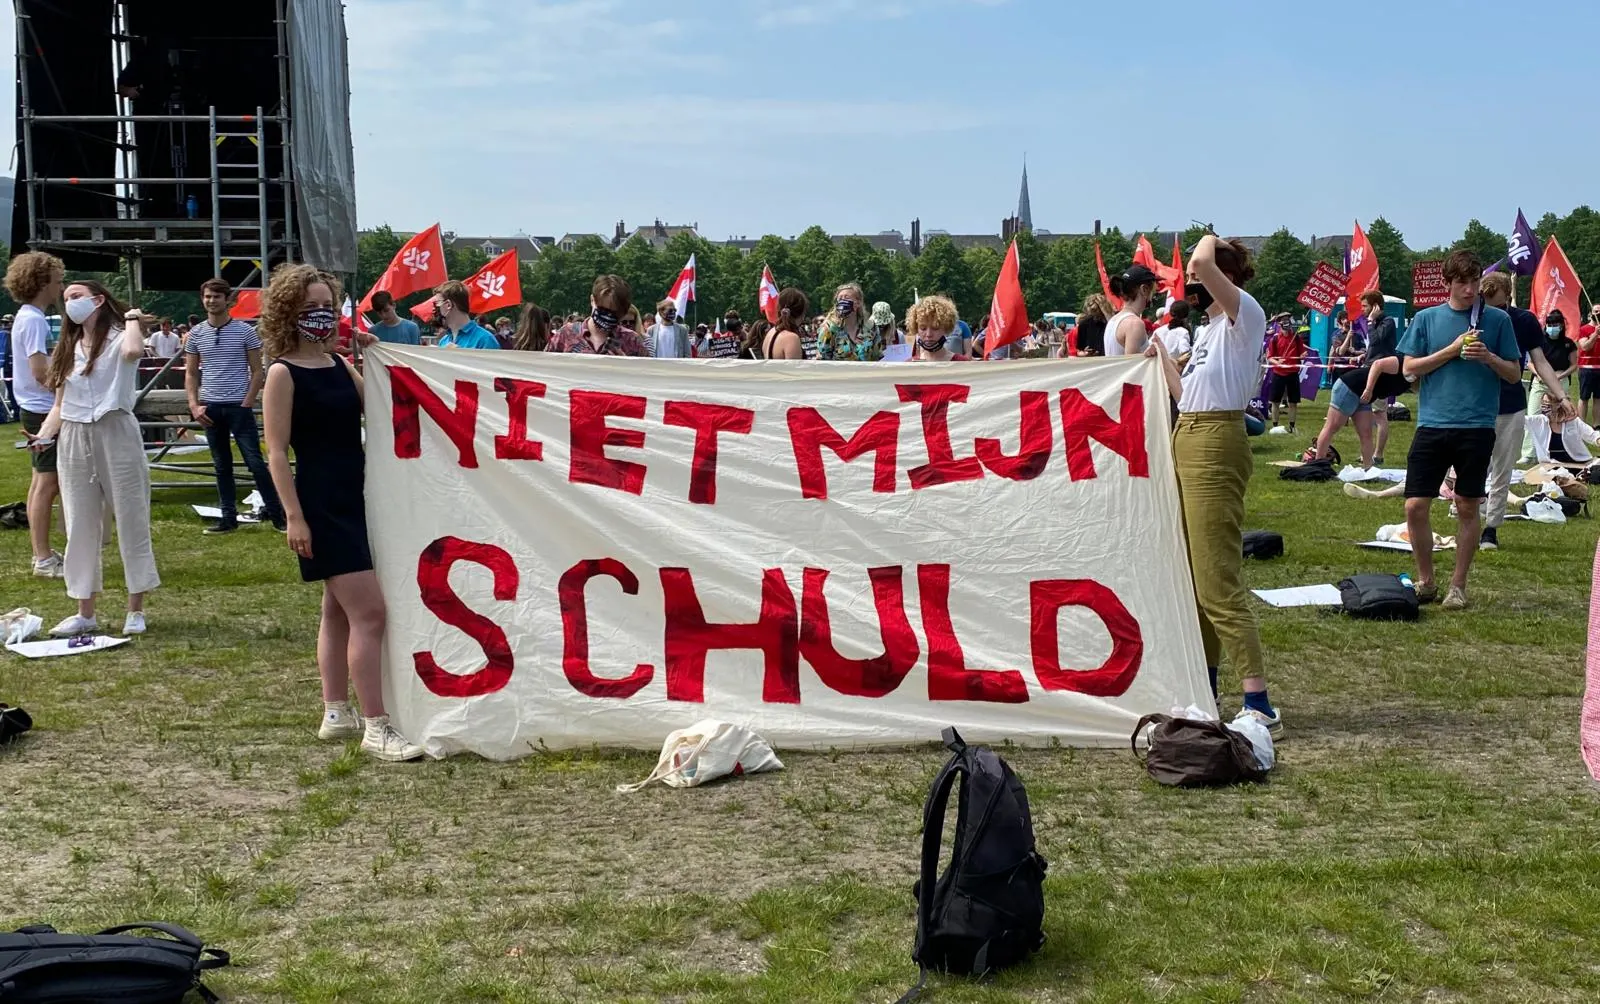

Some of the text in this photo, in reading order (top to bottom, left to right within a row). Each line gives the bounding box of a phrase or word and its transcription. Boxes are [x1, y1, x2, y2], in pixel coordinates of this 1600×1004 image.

[1309, 286, 1331, 303] GOED
[388, 366, 1148, 504] NIET MIJN
[415, 536, 1143, 703] SCHULD
